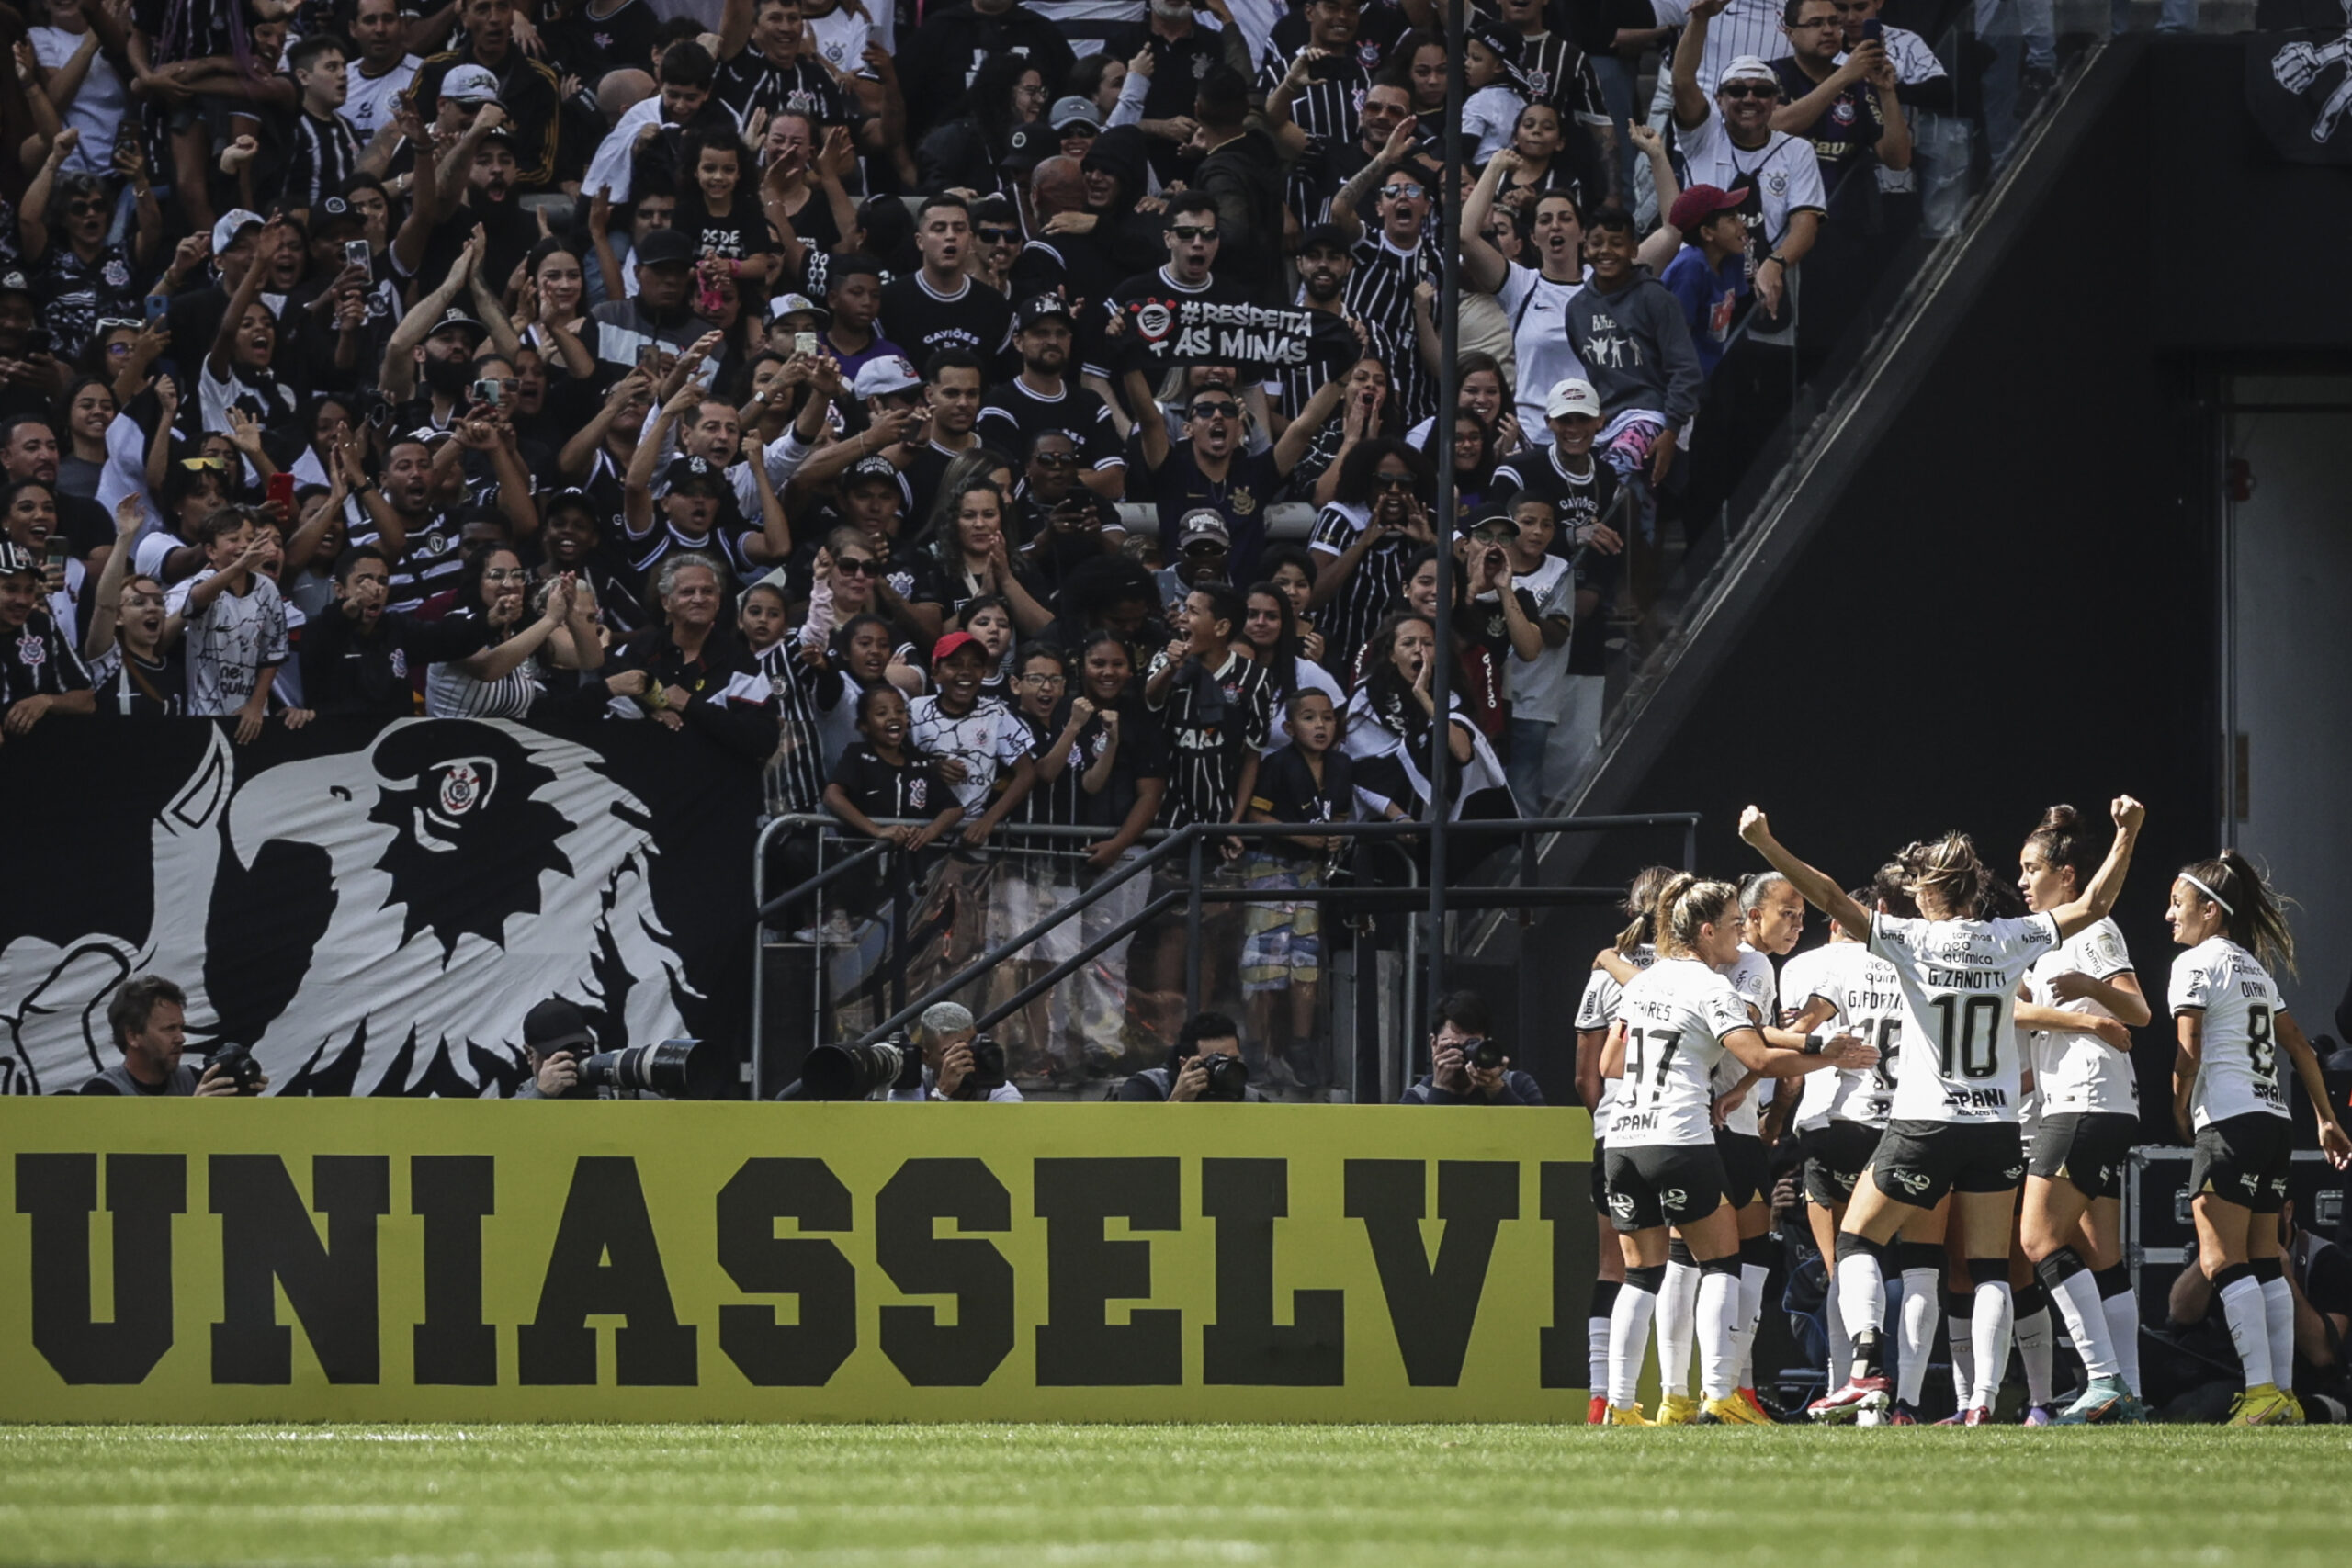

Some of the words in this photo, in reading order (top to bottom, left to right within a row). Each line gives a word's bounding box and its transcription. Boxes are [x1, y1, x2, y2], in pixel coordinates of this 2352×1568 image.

[1180, 300, 1313, 337] #RESPEITA
[922, 327, 981, 345] GAVIÕES
[943, 340, 958, 349] DA
[1219, 328, 1308, 364] MINAS
[1880, 931, 1905, 944] bmg
[1942, 941, 1971, 952] neo
[2029, 932, 2052, 945] bmg
[1942, 952, 1993, 965] química
[1928, 968, 2007, 989] G.ZANOTTI
[1929, 994, 2002, 1080] 10
[2247, 1003, 2275, 1079] 8
[1611, 1111, 1659, 1132] SPANI
[15, 1152, 1599, 1389] UNIASSELVI
